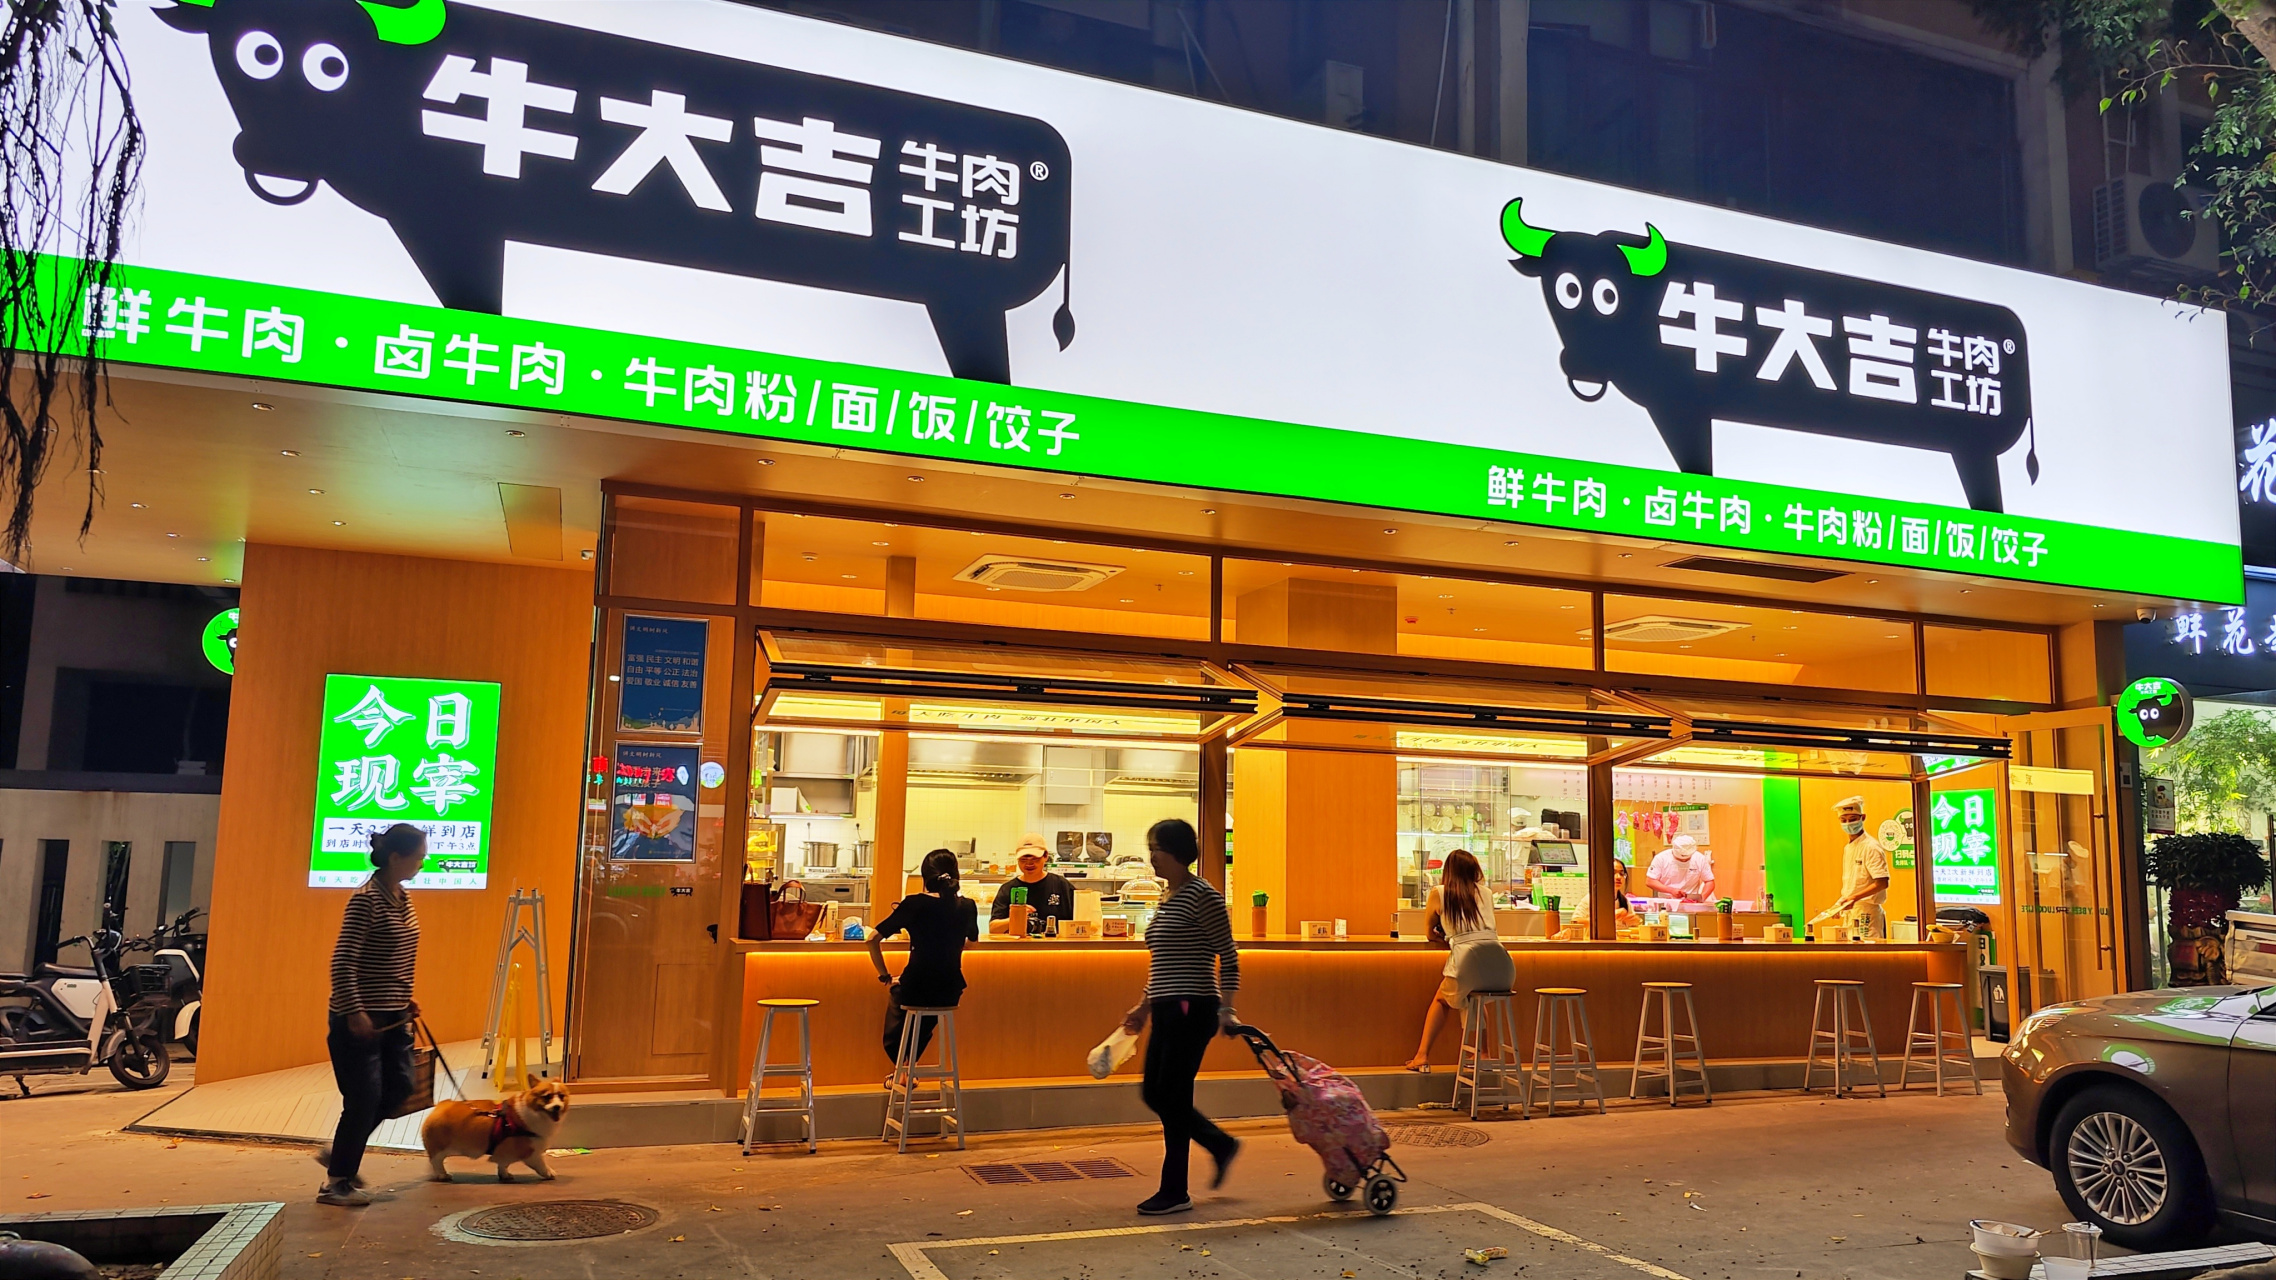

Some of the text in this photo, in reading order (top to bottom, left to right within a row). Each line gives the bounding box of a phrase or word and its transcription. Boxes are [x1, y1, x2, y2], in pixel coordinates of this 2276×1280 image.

[422, 54, 882, 237] 牛大吉
[899, 139, 1020, 206] 牛肉
[898, 193, 1020, 259] 工坊
[1658, 281, 1918, 405] 牛大吉
[1927, 327, 2001, 376] 牛肉
[1930, 368, 2002, 417] 工坊
[2175, 607, 2276, 655] 鲜花
[626, 676, 697, 689] 爱国 敬业 诚信 友善
[627, 654, 699, 667] 富强 民主 文明 和谐
[627, 665, 698, 678] 自由 平等 公正 法治
[2135, 682, 2163, 691] 牛大吉
[333, 684, 473, 750] 今日
[330, 753, 480, 817] 现宰
[329, 823, 476, 839] 一天2鲜到店
[1931, 794, 1985, 830] 今日
[1932, 828, 1992, 865] 现宰
